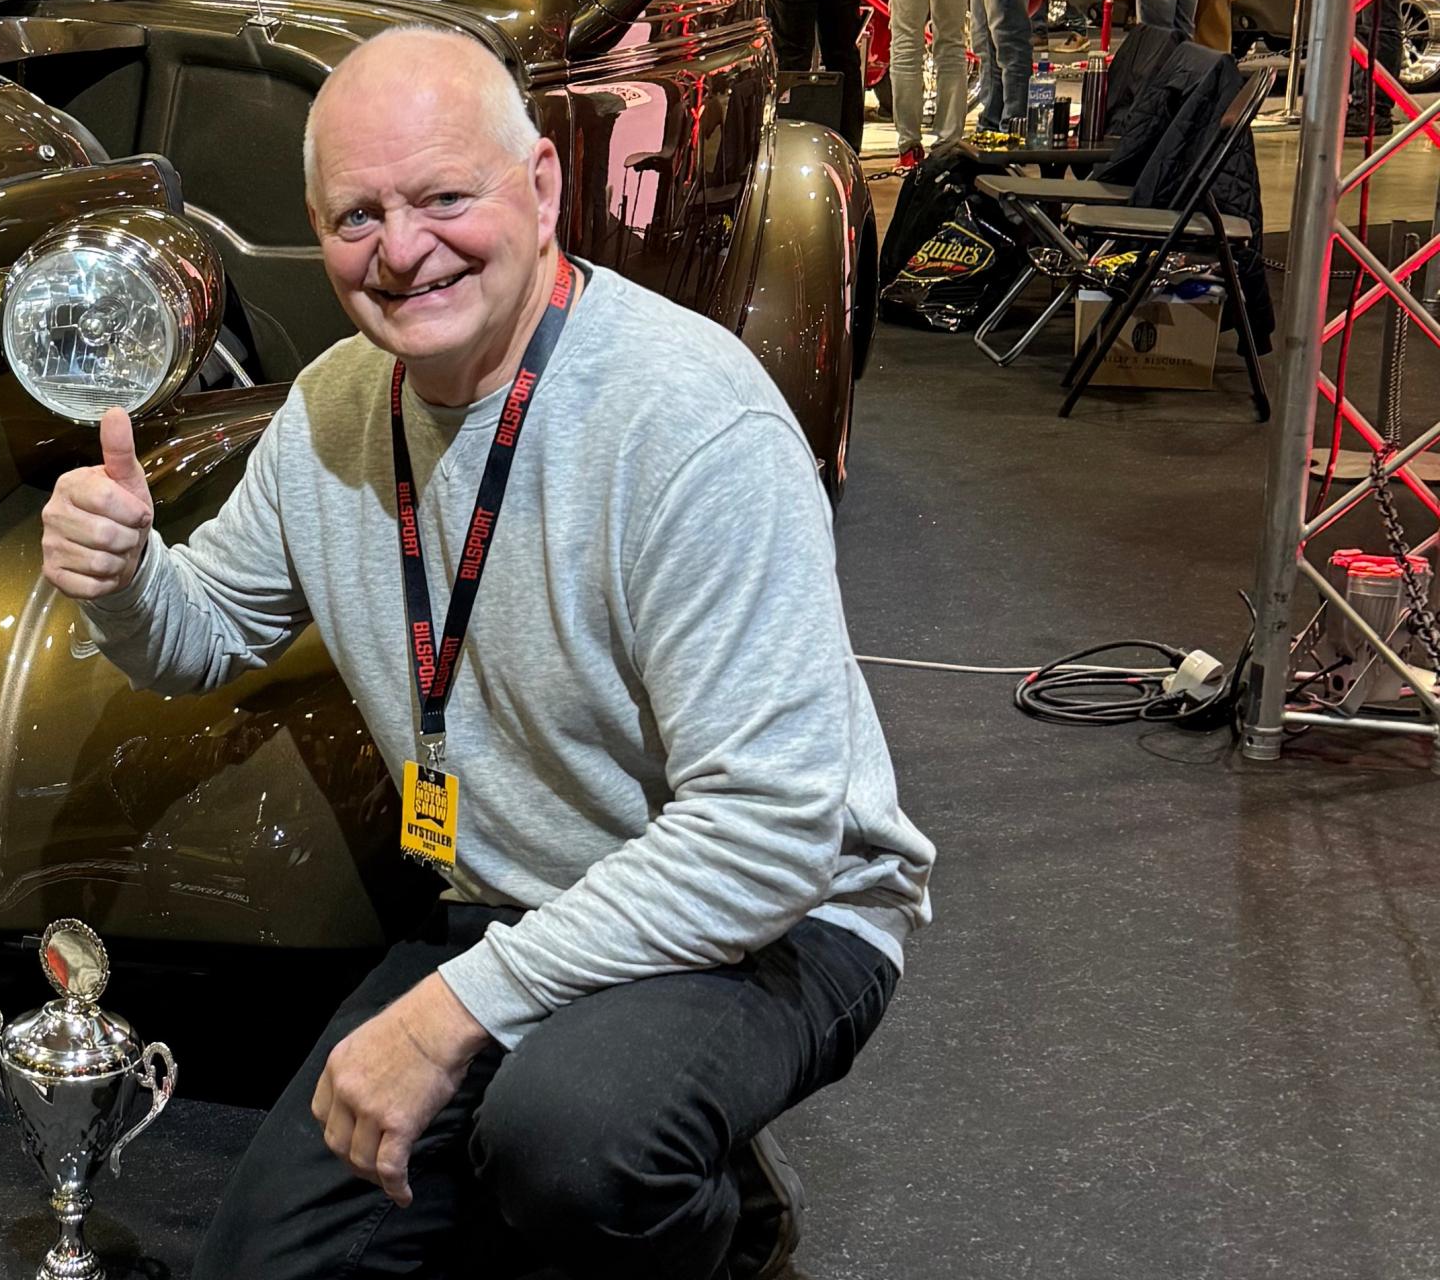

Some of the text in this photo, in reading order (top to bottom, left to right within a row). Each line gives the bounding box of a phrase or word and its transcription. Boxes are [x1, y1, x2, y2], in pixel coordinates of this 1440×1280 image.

[496, 367, 537, 448] BILSPORT
[399, 482, 421, 558] BILSPORT
[460, 506, 495, 580] BILSPORT
[415, 799, 447, 822] SHOW
[416, 787, 448, 809] MOTOR
[407, 822, 452, 848] UTSTILLER
